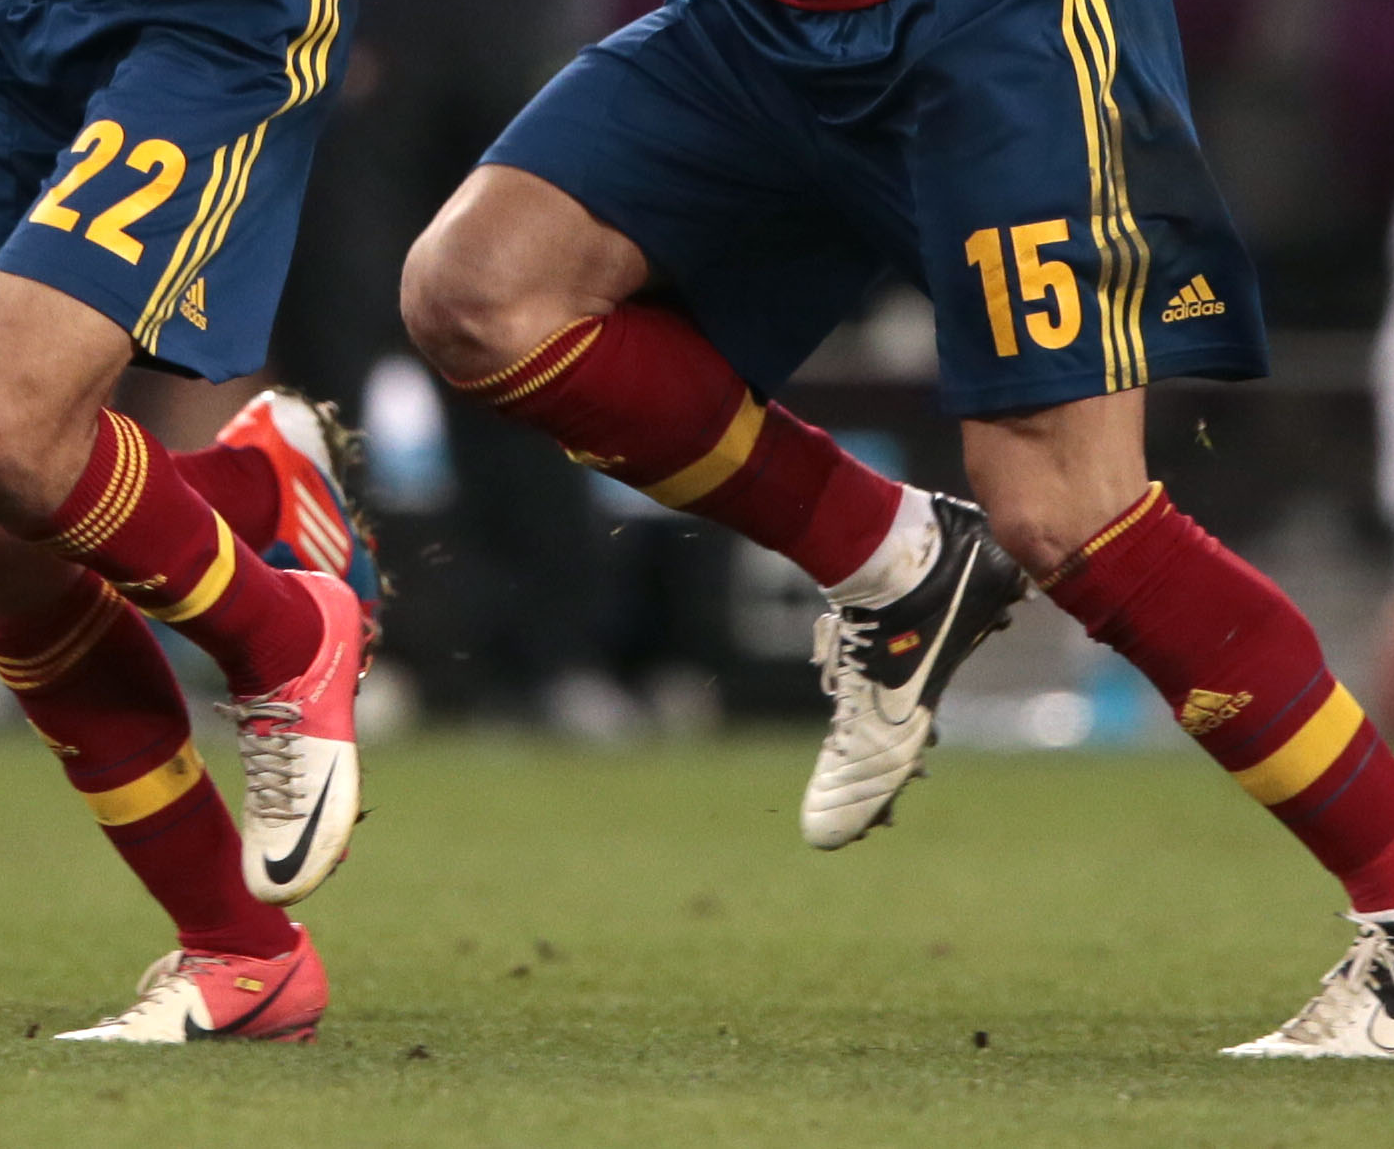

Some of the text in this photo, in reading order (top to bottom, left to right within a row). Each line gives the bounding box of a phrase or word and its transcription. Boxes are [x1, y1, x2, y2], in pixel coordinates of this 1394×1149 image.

[28, 119, 187, 266] 22
[964, 218, 1082, 358] 15
[1161, 300, 1226, 323] adidas
